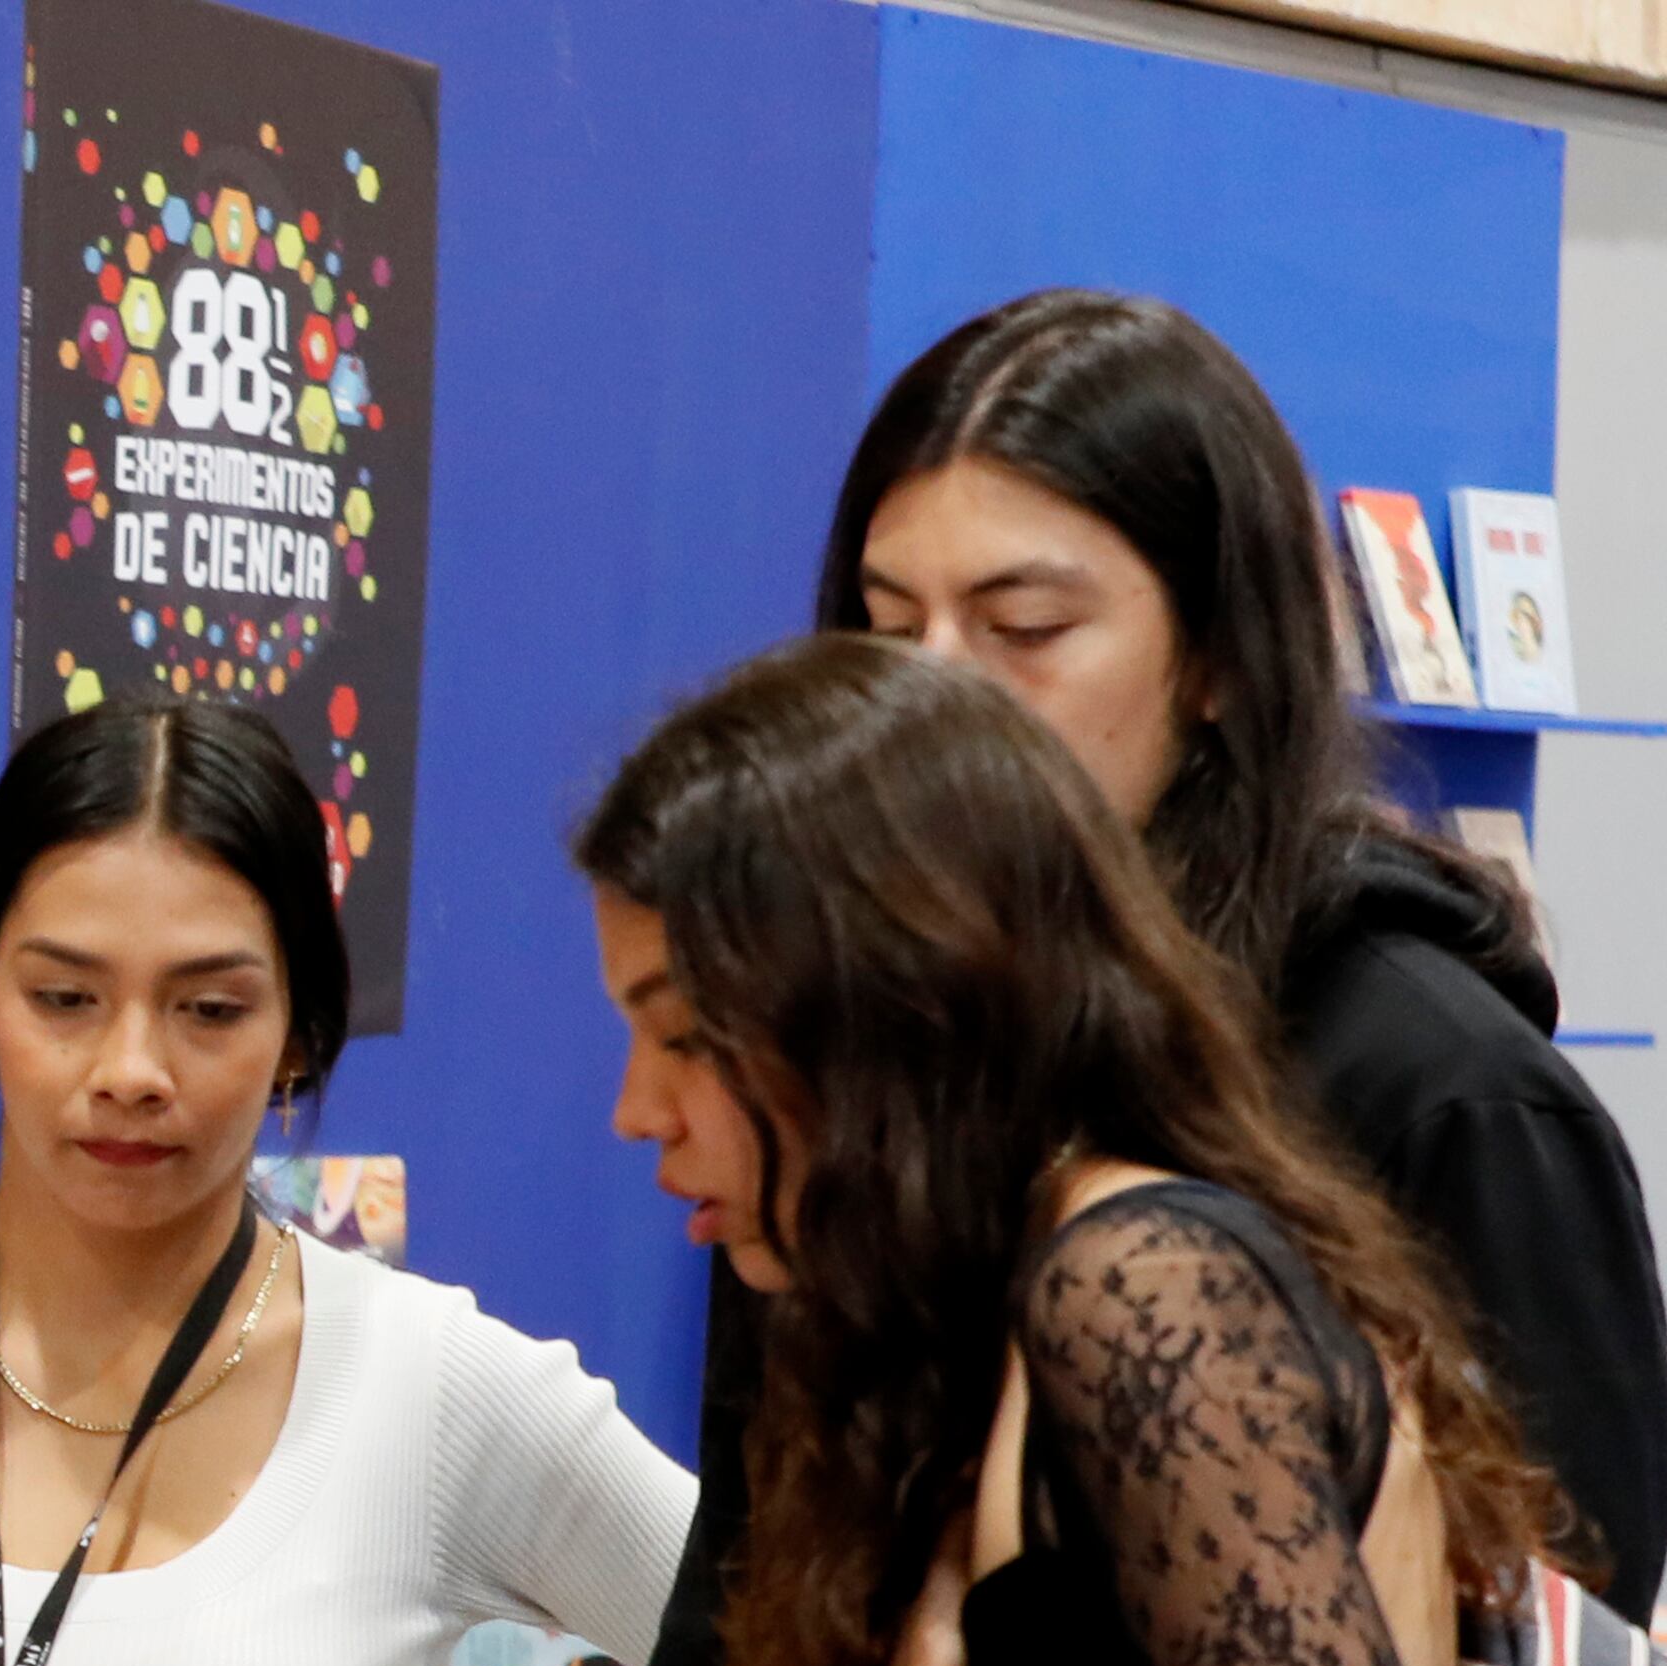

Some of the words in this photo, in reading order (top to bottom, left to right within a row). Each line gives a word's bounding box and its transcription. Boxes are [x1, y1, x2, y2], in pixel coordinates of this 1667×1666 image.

[115, 435, 336, 519] EXPERIMENTOS
[113, 511, 169, 584] DE
[182, 512, 331, 602] CIENCIA
